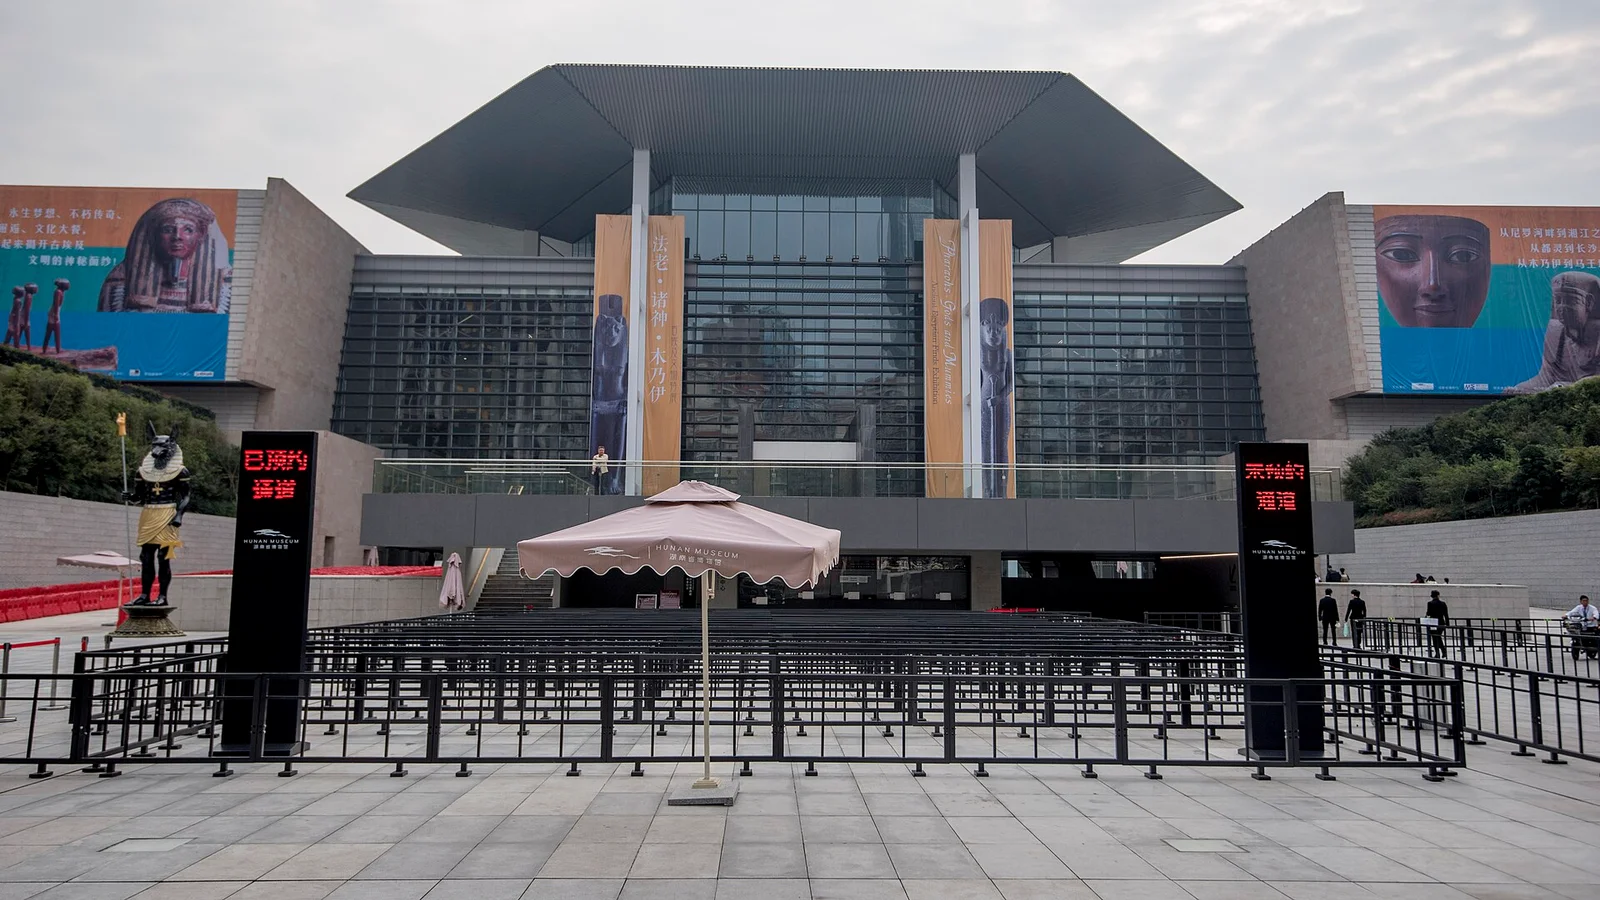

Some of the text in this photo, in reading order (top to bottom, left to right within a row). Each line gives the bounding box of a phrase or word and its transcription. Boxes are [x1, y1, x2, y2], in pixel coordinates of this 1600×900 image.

[1517, 258, 1600, 269] 从木乃伊到马王
[940, 298, 956, 326] Gods
[944, 330, 954, 349] and
[943, 349, 956, 405] Mummies
[656, 544, 739, 559] HUNAN MUSEUM
